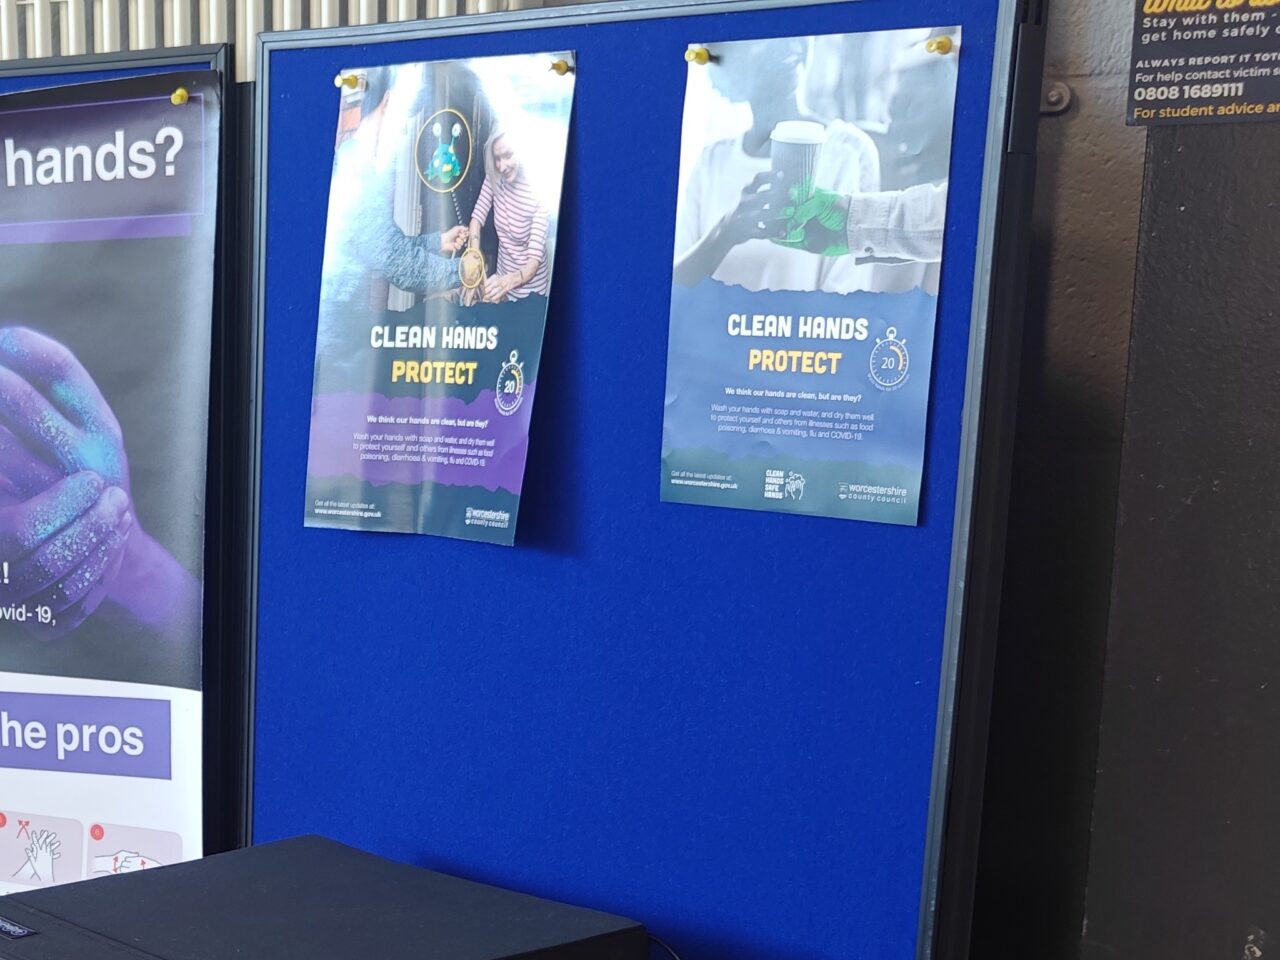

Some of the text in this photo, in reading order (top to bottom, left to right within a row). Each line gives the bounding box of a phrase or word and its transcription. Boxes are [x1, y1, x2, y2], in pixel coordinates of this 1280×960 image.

[1142, 12, 1265, 29] Stay with them
[1141, 31, 1167, 44] get
[1172, 28, 1216, 40] home
[1222, 25, 1269, 38] safely
[1136, 58, 1185, 68] ALWAYS
[1189, 55, 1235, 65] REPORT
[1239, 54, 1249, 62] IT
[1135, 72, 1153, 83] For
[1157, 70, 1182, 83] help
[1185, 69, 1230, 80] contact
[1233, 66, 1270, 78] victim
[1134, 82, 1243, 101] 0808 1689111
[1134, 108, 1156, 119] For
[1158, 105, 1213, 118] student
[1217, 102, 1263, 115] advice
[4, 126, 185, 188] hands?
[727, 313, 868, 340] CLEAN HANDS
[370, 326, 498, 350] CLEAN HANDS
[749, 349, 842, 374] PROTECT
[881, 357, 894, 369] 20
[391, 360, 477, 385] PROTECT
[504, 380, 514, 394] 20
[725, 387, 735, 395] We
[736, 388, 752, 396] think
[765, 390, 784, 398] hands
[798, 391, 816, 400] clean,
[843, 393, 862, 403] they?
[711, 404, 727, 412] Wash
[728, 406, 741, 414] your
[742, 406, 759, 414] hands
[761, 407, 772, 415] with
[774, 409, 788, 417] soap
[802, 410, 819, 418] water,
[834, 412, 844, 420] dry
[845, 412, 860, 420] them
[862, 413, 874, 421] well
[367, 415, 377, 423] We
[409, 416, 429, 424] hands
[441, 418, 456, 427] clean,
[457, 419, 465, 427] but
[475, 420, 488, 429] they?
[717, 415, 738, 423] protect
[739, 416, 761, 424] yourself
[775, 418, 793, 426] others
[809, 420, 833, 428] illnesses
[835, 421, 849, 429] such
[860, 423, 873, 431] food
[764, 491, 783, 499] HANDS
[849, 484, 907, 497] worcestershire
[849, 492, 907, 504] county council
[56, 720, 144, 760] pros
